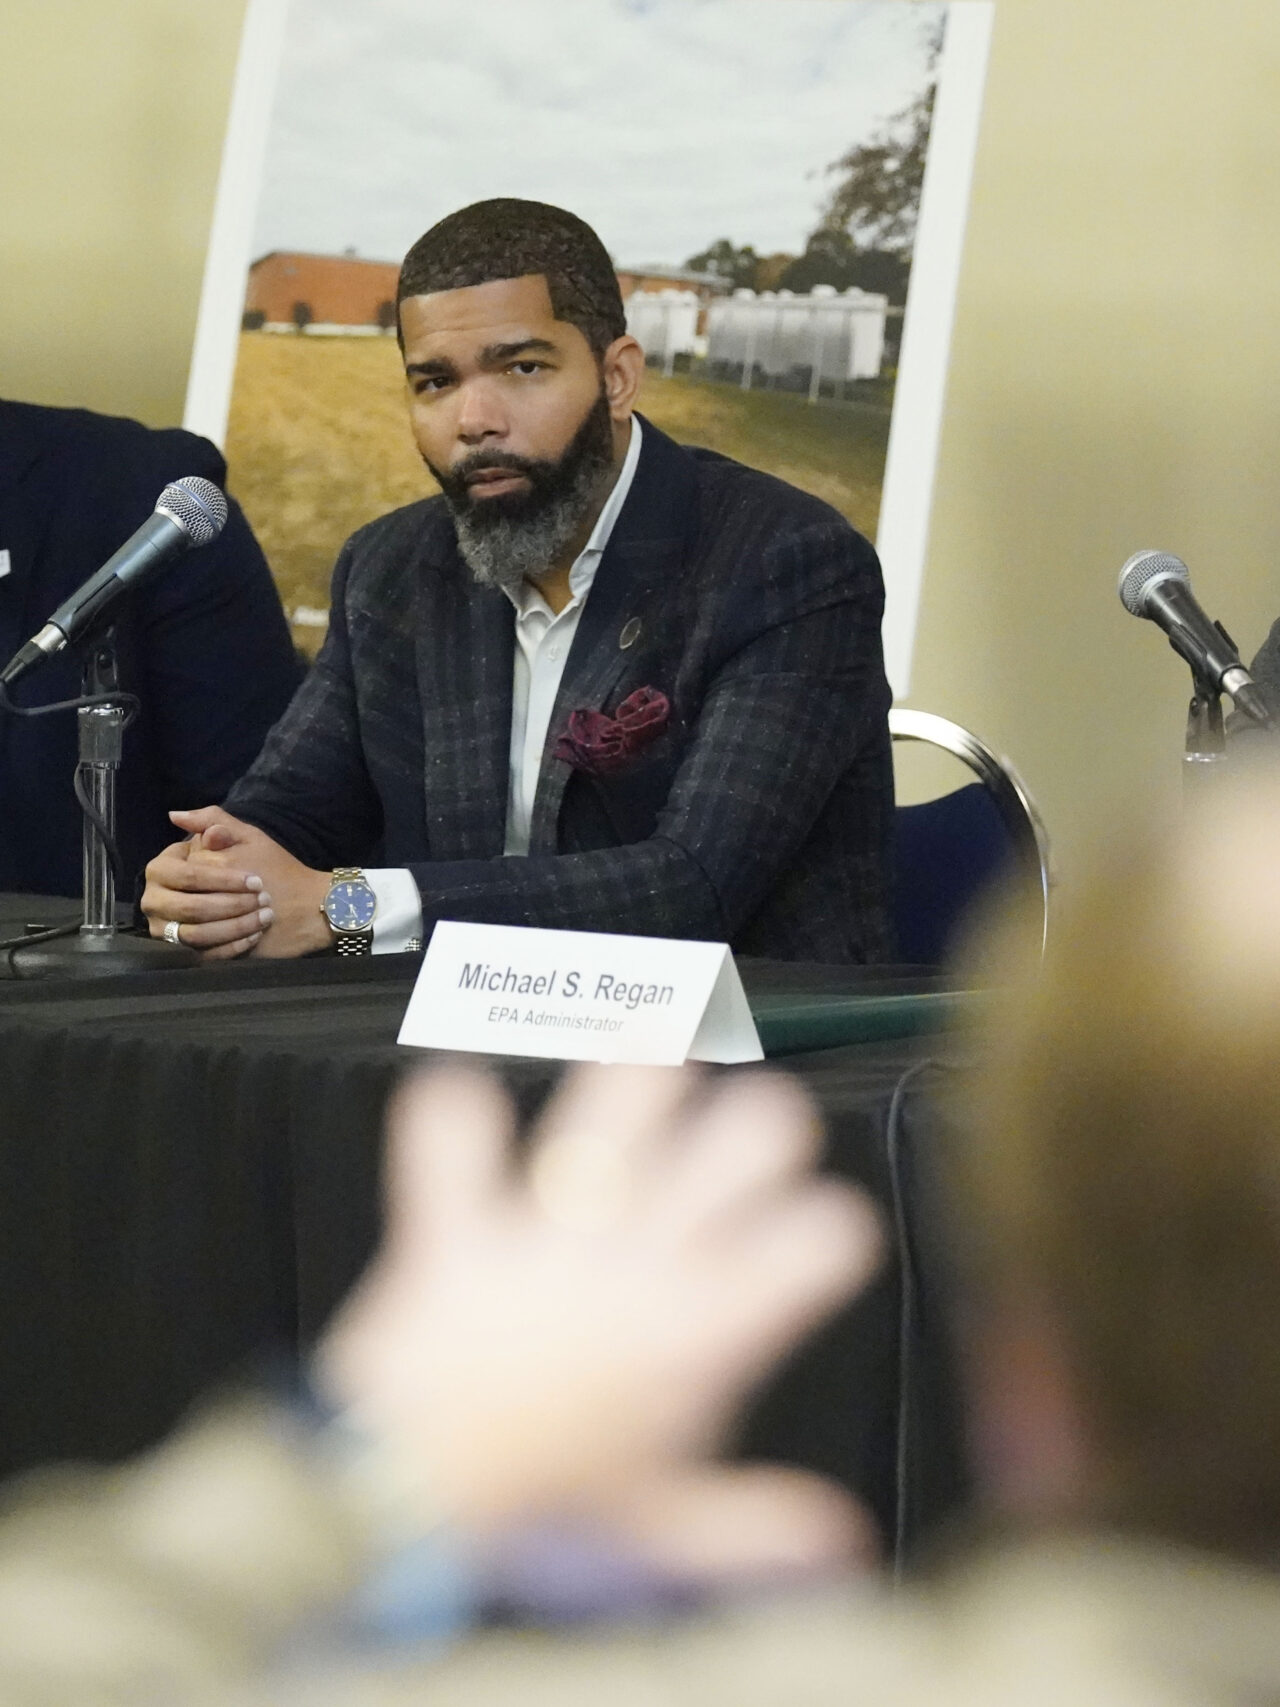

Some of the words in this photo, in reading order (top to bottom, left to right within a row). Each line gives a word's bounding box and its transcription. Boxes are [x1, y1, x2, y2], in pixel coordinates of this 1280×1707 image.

[457, 962, 558, 996] Michael
[561, 970, 584, 999] S.
[593, 973, 675, 1010] Regan
[487, 1006, 519, 1024] EPA
[522, 1008, 625, 1033] Administrator
